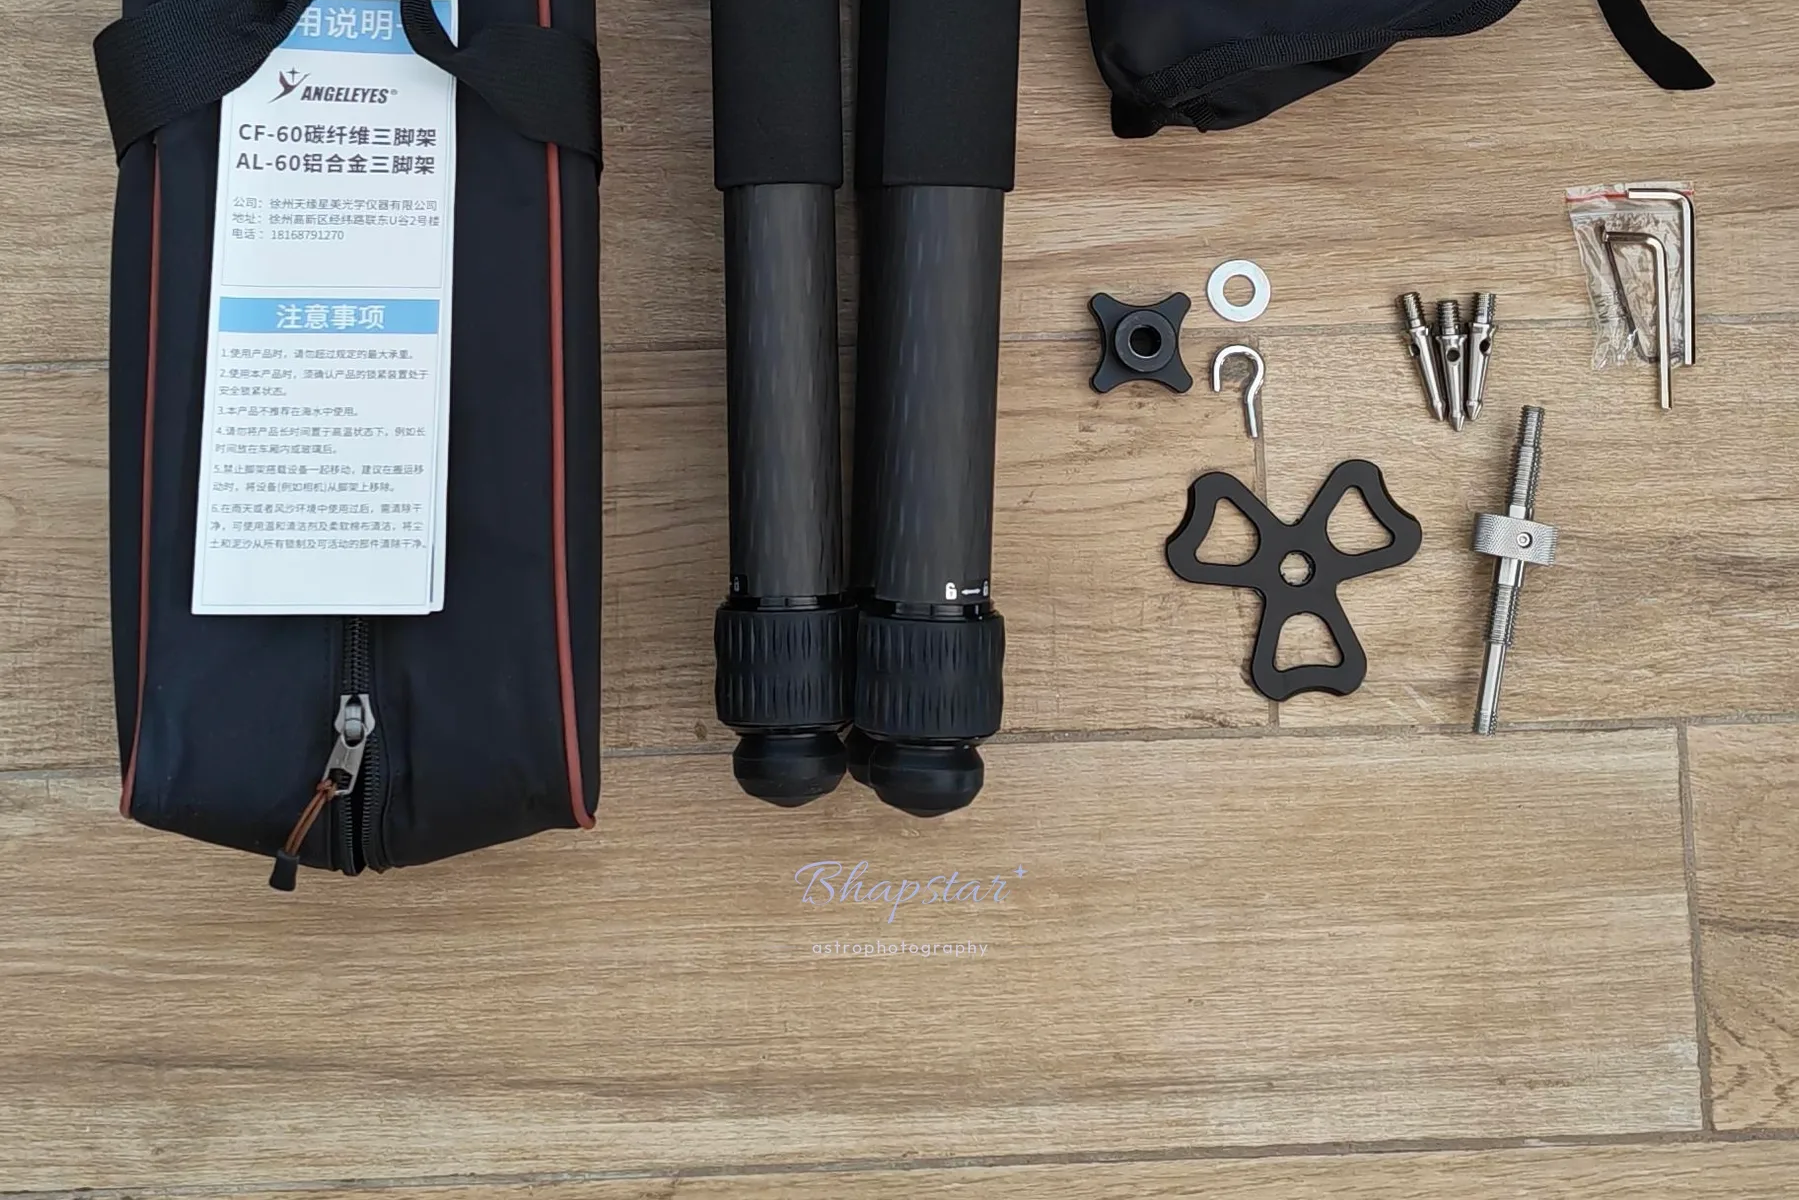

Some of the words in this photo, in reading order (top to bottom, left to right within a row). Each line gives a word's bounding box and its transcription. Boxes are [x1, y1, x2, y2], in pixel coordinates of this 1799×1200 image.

[298, 7, 403, 40] 用说明
[238, 123, 437, 147] CF-60碳纤维三脚架
[236, 152, 436, 175] AL-60铝合金三脚架
[276, 303, 386, 330] 注意事项
